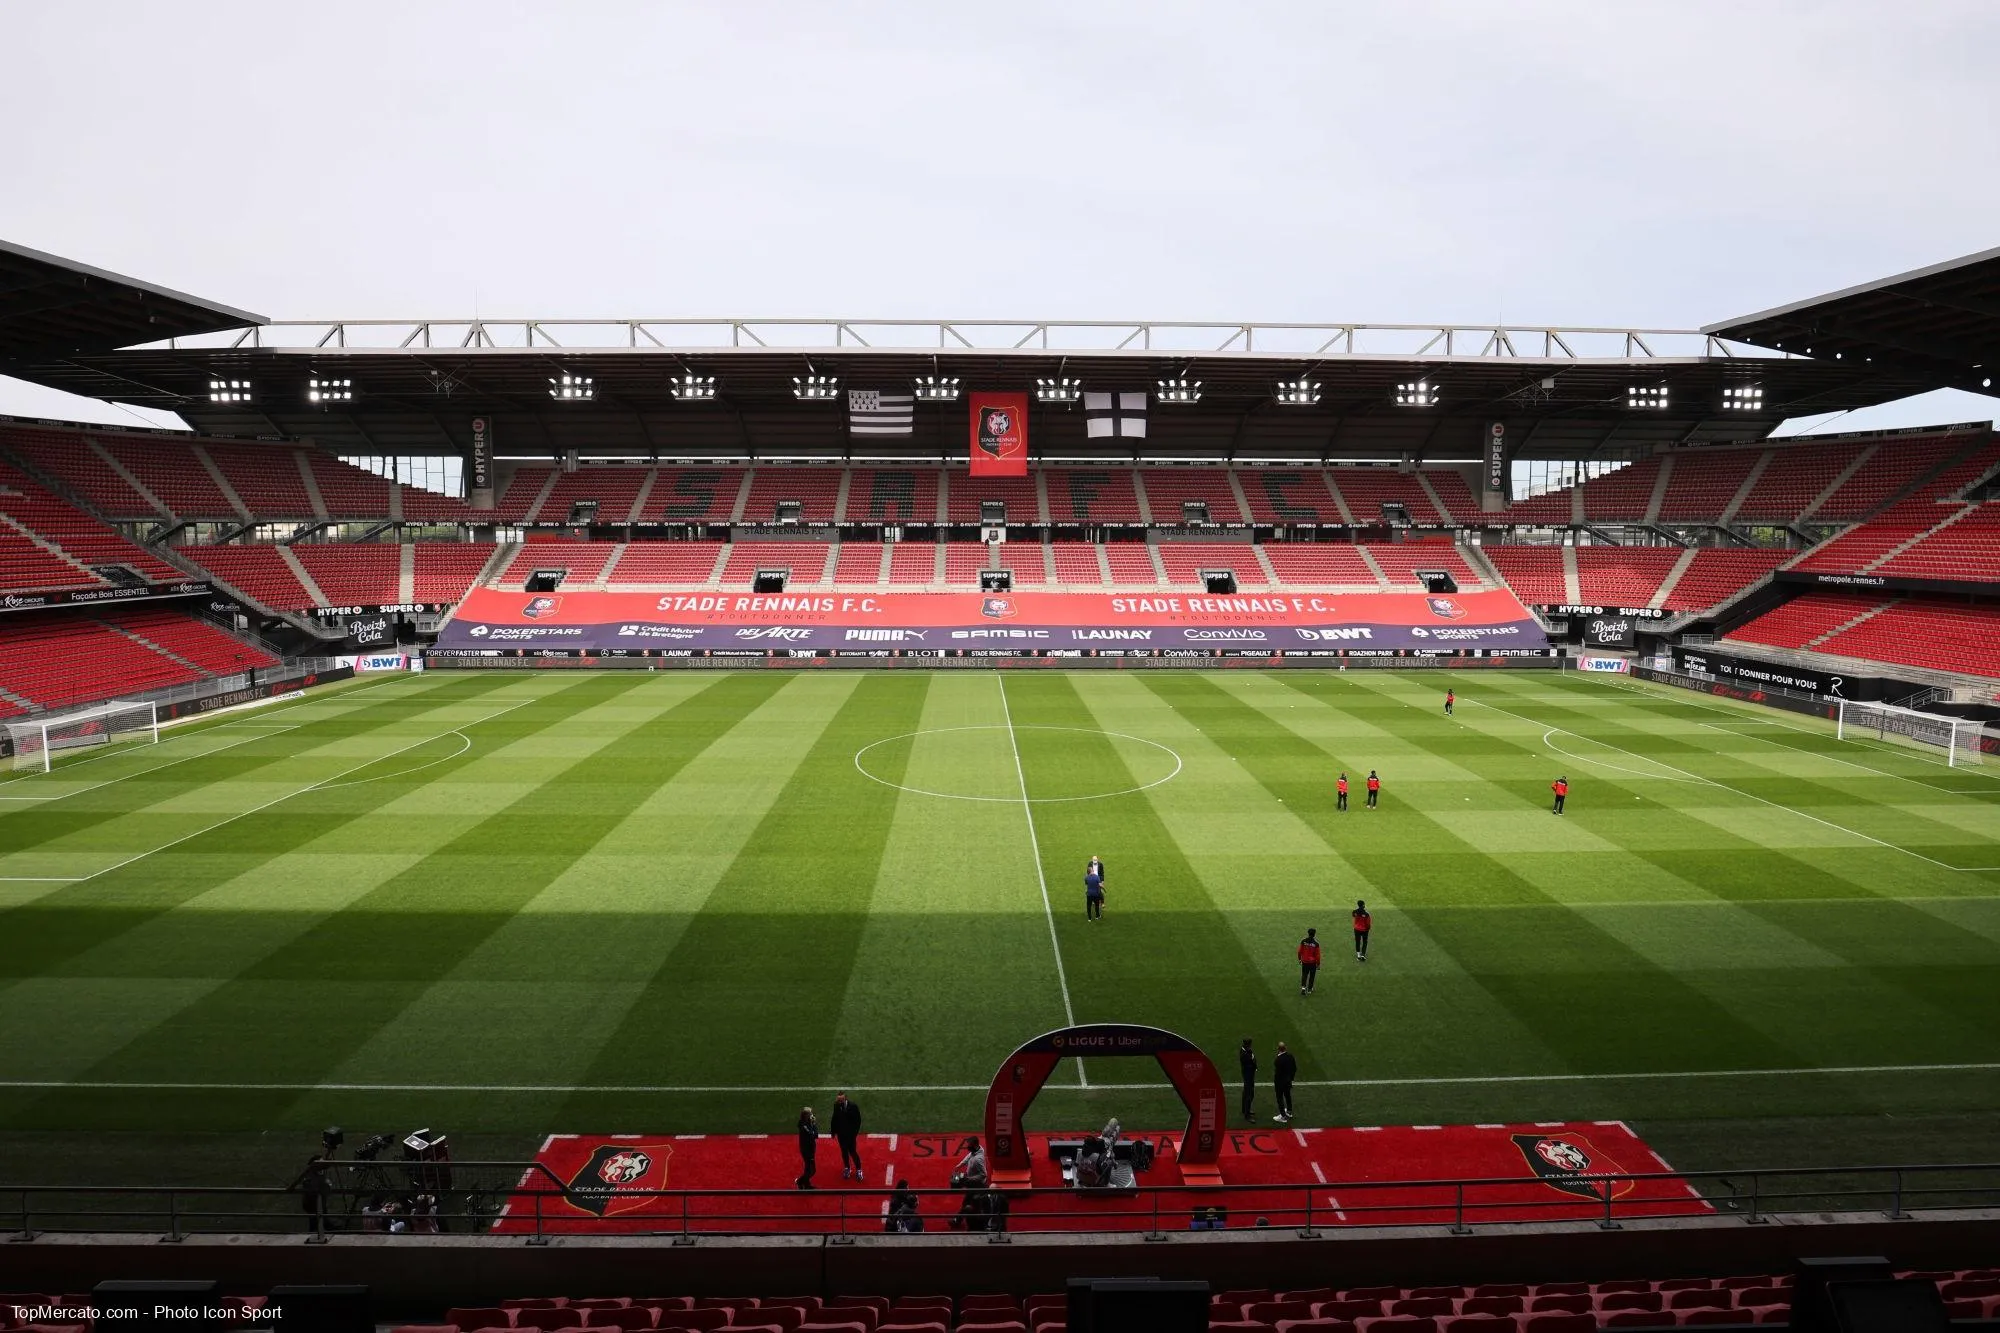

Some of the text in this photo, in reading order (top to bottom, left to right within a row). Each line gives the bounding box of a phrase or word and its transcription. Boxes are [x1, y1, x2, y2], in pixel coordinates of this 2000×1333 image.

[474, 432, 485, 473] HYPER
[1492, 438, 1503, 477] SUPER
[665, 471, 723, 518] S
[1068, 471, 1111, 518] F
[1262, 471, 1319, 518] C
[1818, 574, 1885, 586] metropole.rennes.fr
[4, 594, 24, 608] Rose
[71, 587, 150, 603] Façade Bois ESSENTIEL
[317, 606, 352, 616] HYPER
[380, 604, 414, 614] SUPER
[656, 597, 883, 613] STADE RENNAIS F.C.
[1112, 598, 1336, 613] STADE RENNAIS F.C.
[1559, 605, 1593, 614] HYPER
[1619, 607, 1652, 617] SUPER
[350, 618, 386, 635] Breizh
[491, 628, 583, 636] POKERSTARS
[641, 625, 704, 635] Crédit Mutuel
[1431, 626, 1520, 637] POKERSTARS
[1591, 619, 1628, 634] Breizh
[358, 632, 383, 644] Cola
[651, 632, 694, 641] Bretagne
[844, 629, 905, 641] PUMA
[951, 630, 1050, 639] SAMSIC
[1319, 628, 1373, 641] BWT
[1598, 631, 1622, 643] Cola
[796, 650, 817, 658] BWT
[372, 658, 402, 669] BWT
[457, 658, 482, 667] STADE
[483, 658, 516, 667] RENNAIS
[687, 658, 711, 667] STADE
[712, 658, 746, 667] RENNAIS
[917, 658, 941, 667] STADE
[942, 658, 975, 667] RENNAIS
[1145, 658, 1169, 667] STADE
[1170, 658, 1203, 667] RENNAIS
[1370, 658, 1395, 667] STADE
[1396, 658, 1428, 667] RENNAIS
[1594, 660, 1622, 670] BWT
[1651, 671, 1669, 684] STADE
[1669, 674, 1695, 689] RENNAIS
[1739, 667, 1771, 682] DONNER
[1771, 673, 1793, 686] POUR
[1795, 677, 1817, 690] VOUS
[200, 694, 224, 710] STADE
[224, 690, 254, 706] RENNAIS
[1068, 1037, 1105, 1046] LIGUE
[1108, 1037, 1114, 1046] 1
[1118, 1036, 1142, 1046] Uber
[1230, 1134, 1278, 1154] FC
